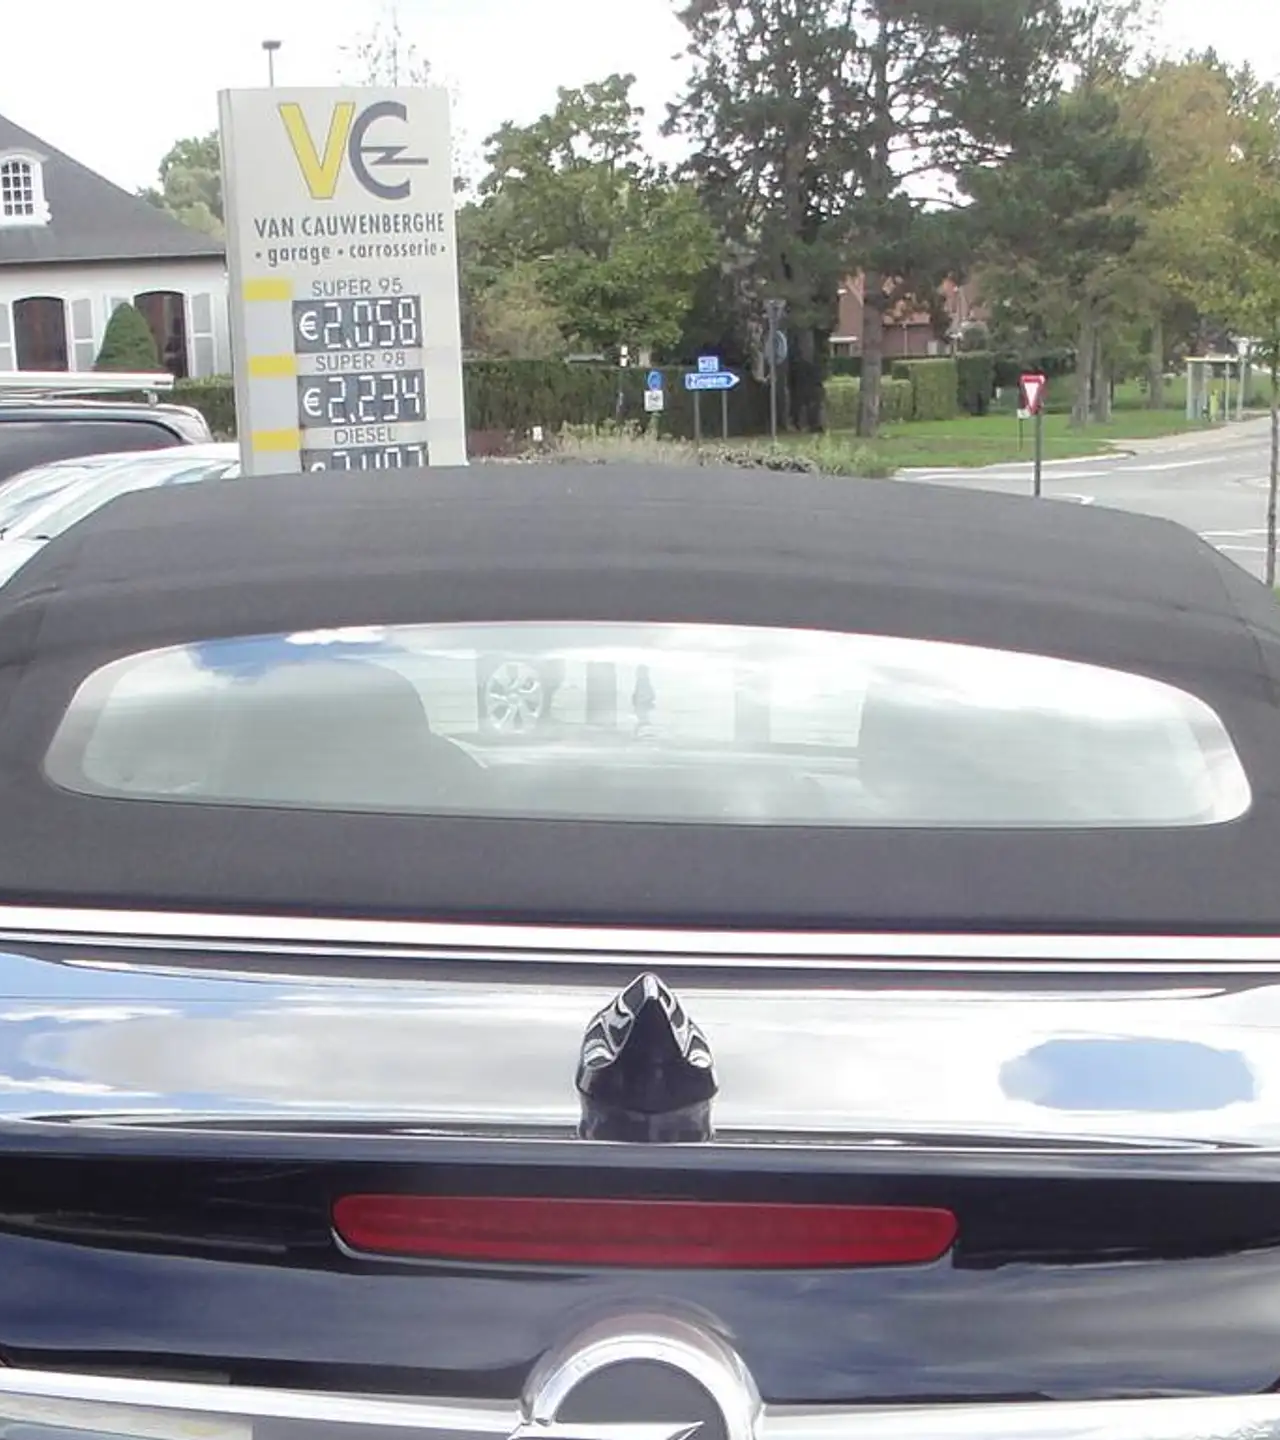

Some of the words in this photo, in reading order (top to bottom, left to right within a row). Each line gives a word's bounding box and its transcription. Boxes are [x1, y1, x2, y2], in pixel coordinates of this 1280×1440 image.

[254, 217, 295, 239] VAN
[301, 212, 445, 237] CAUWENBERGHE
[267, 245, 331, 267] garage
[348, 239, 438, 259] carrosserie
[311, 279, 372, 297] SUPER
[378, 277, 404, 294] 95
[315, 353, 375, 372] SUPER
[381, 351, 406, 368] 98
[333, 427, 397, 445] DIESEL
